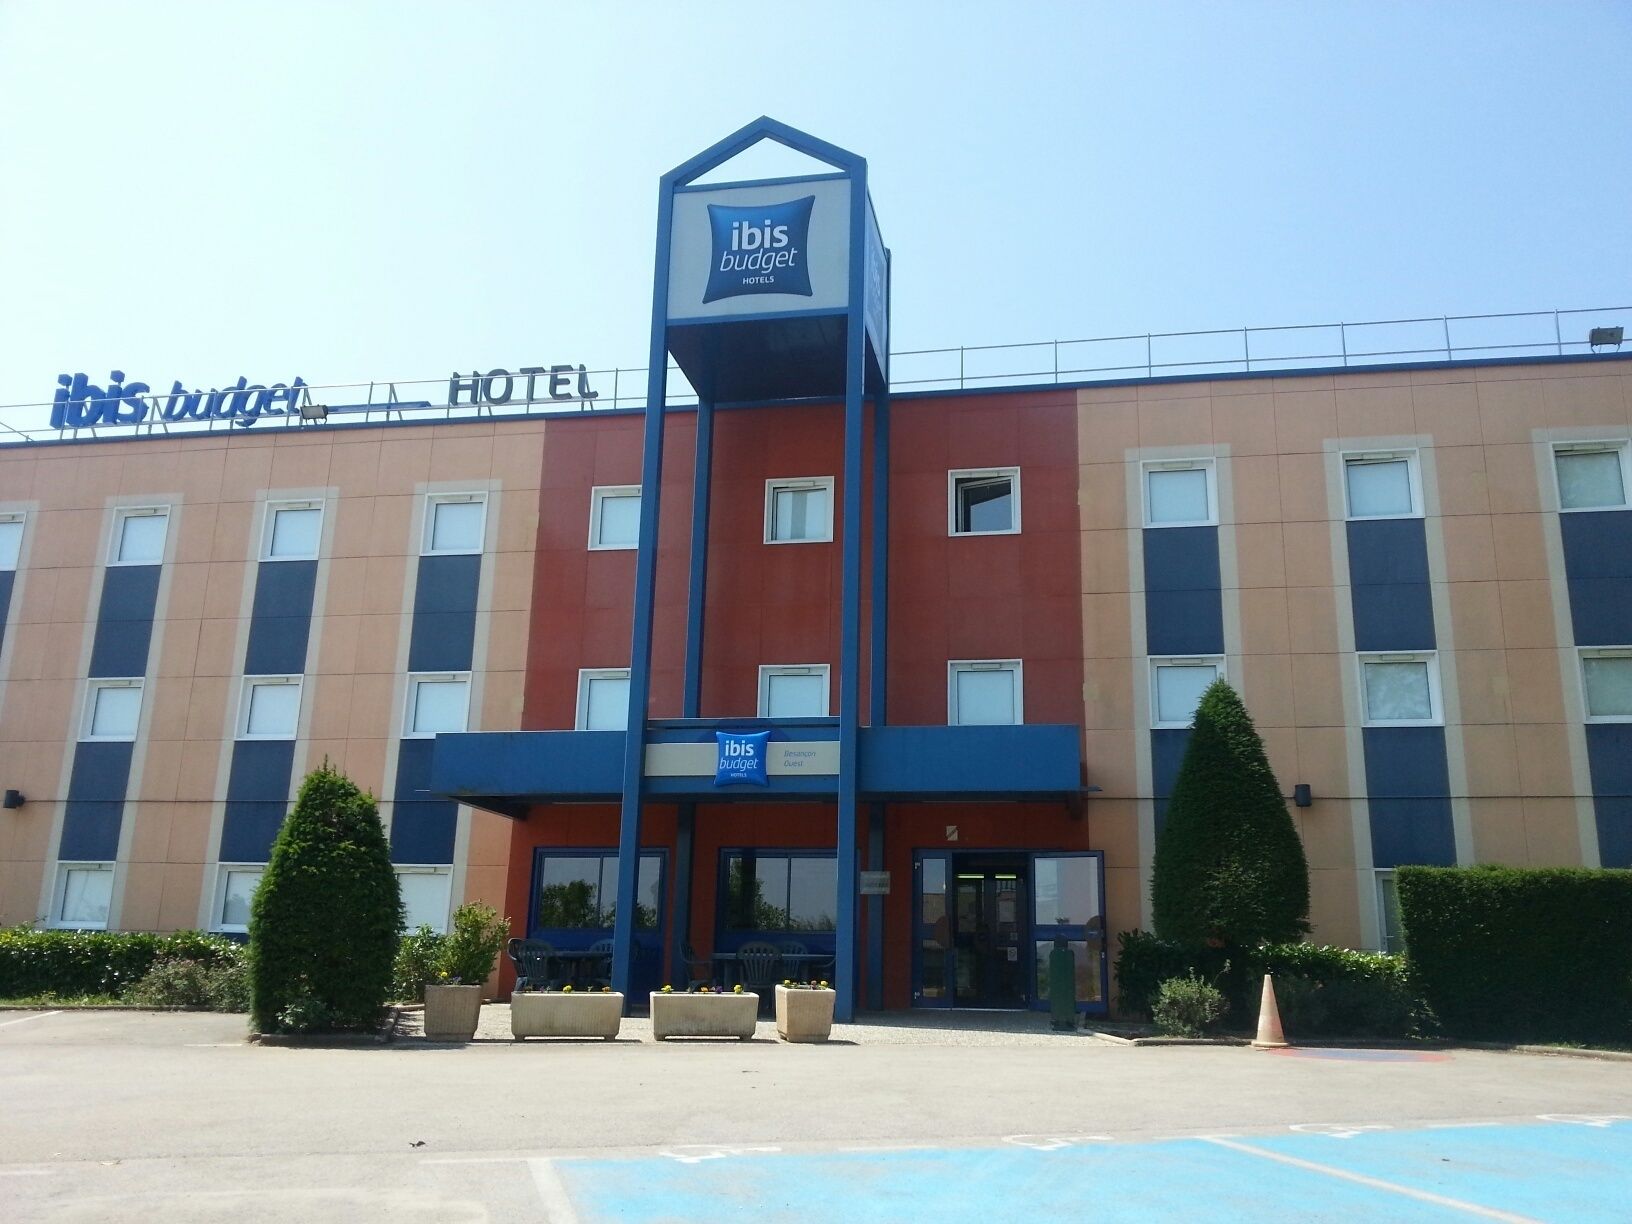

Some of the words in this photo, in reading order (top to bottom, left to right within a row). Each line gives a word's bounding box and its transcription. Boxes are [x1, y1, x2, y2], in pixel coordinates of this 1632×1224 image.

[731, 219, 789, 251] ibis
[719, 247, 798, 274] budget
[742, 276, 775, 285] HOTELS
[449, 363, 599, 406] HOTEL
[50, 370, 151, 429] ibis
[162, 376, 308, 428] budget
[725, 740, 755, 756] ibis
[719, 757, 759, 772] budget
